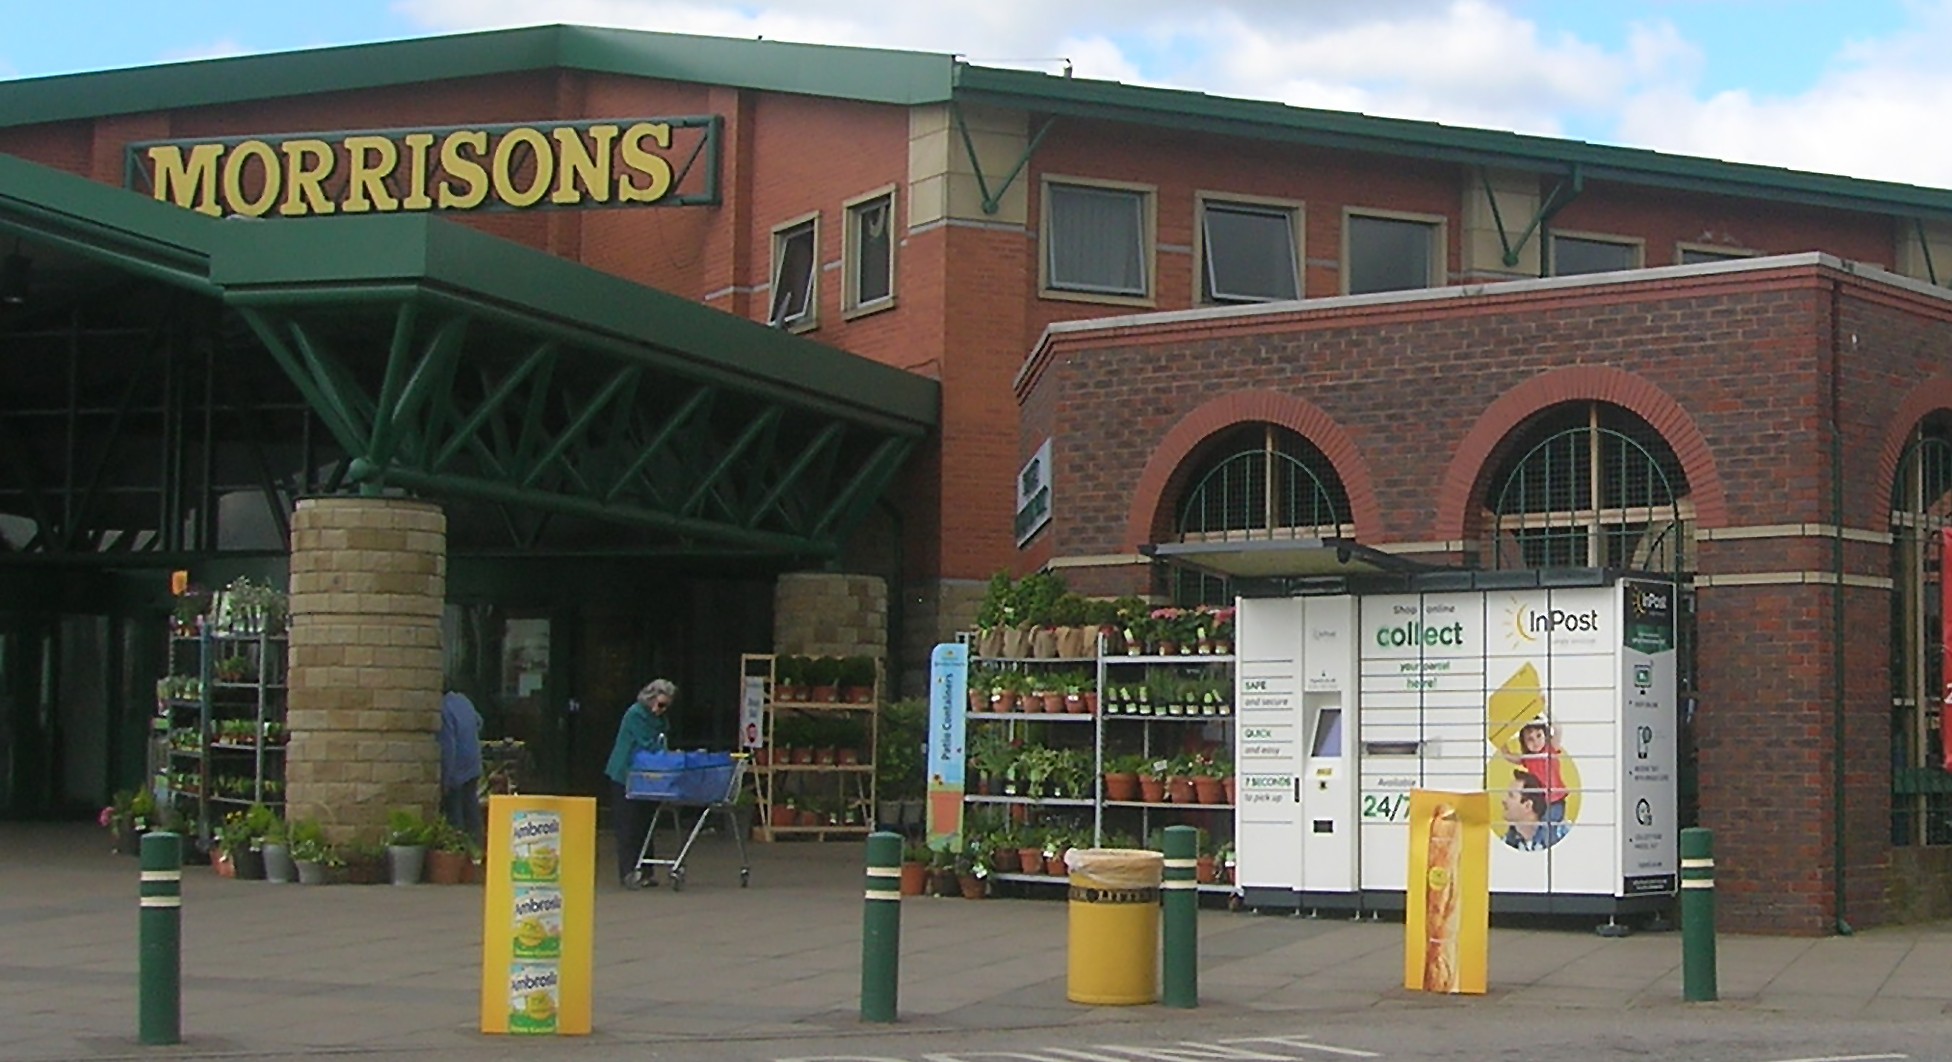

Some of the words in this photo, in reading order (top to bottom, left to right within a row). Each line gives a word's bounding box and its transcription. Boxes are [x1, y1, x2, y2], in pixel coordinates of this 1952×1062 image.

[149, 122, 674, 218] MORRISONS
[1393, 605, 1417, 615] Shop
[1426, 604, 1455, 614] online
[1529, 609, 1599, 632] InPost
[1376, 621, 1463, 647] collect
[942, 672, 953, 730] Containers
[940, 732, 951, 761] Patio
[1244, 729, 1272, 738] QUICK
[1252, 777, 1291, 786] SECONDS
[1363, 794, 1411, 821] 24/7
